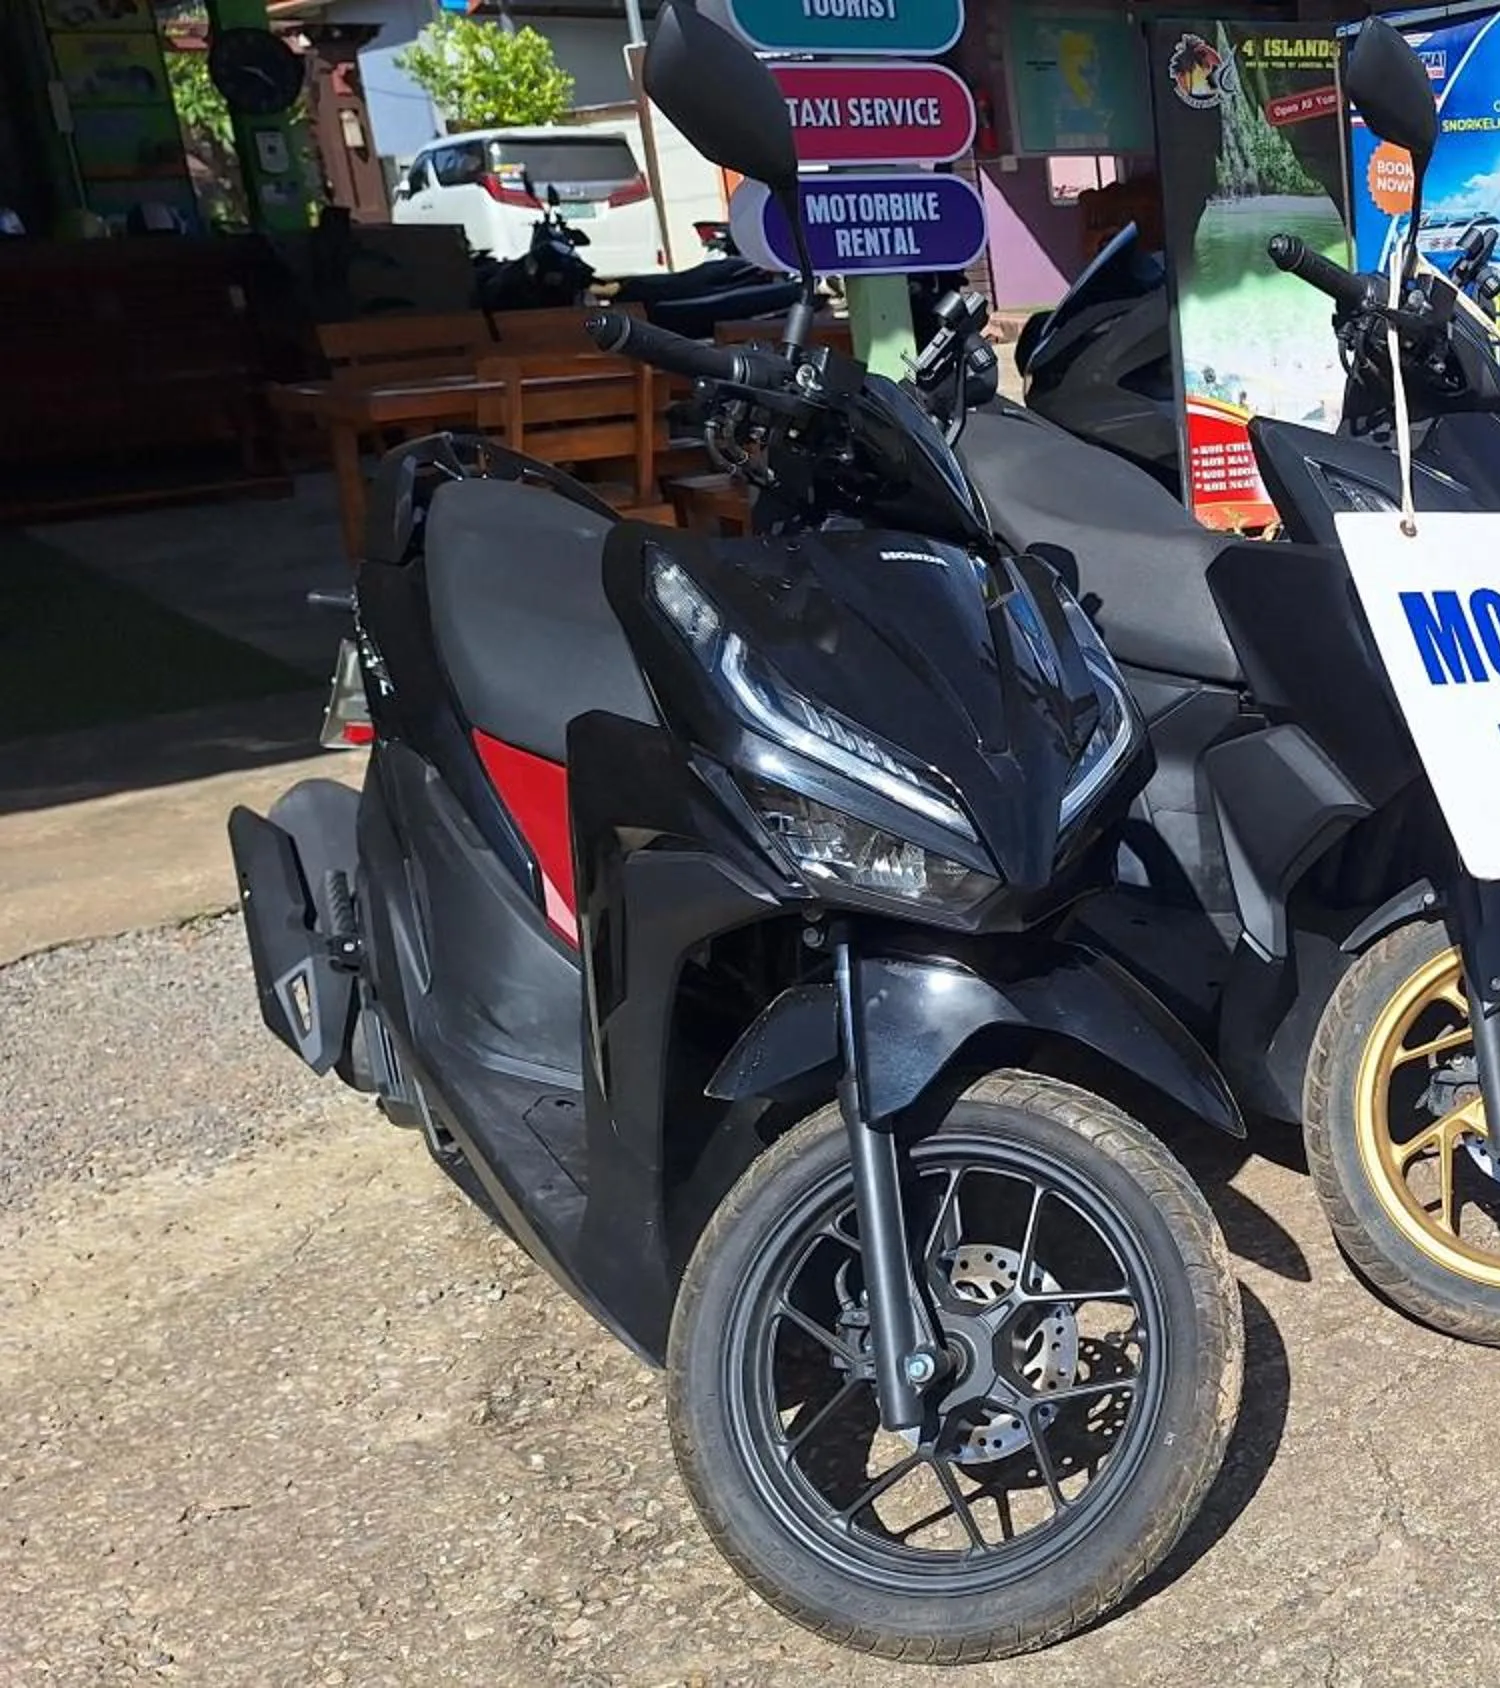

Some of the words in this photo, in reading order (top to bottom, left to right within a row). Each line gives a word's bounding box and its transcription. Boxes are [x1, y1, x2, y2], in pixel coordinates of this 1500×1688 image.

[802, 0, 897, 20] TOURIST
[1242, 39, 1254, 57] 4
[1263, 38, 1340, 57] ISLANDS
[786, 98, 840, 128] TAXI
[848, 97, 942, 127] SERVICE
[1377, 161, 1413, 177] BOOK
[806, 192, 940, 225] MOTORBIKE
[835, 227, 920, 257] RENTAL
